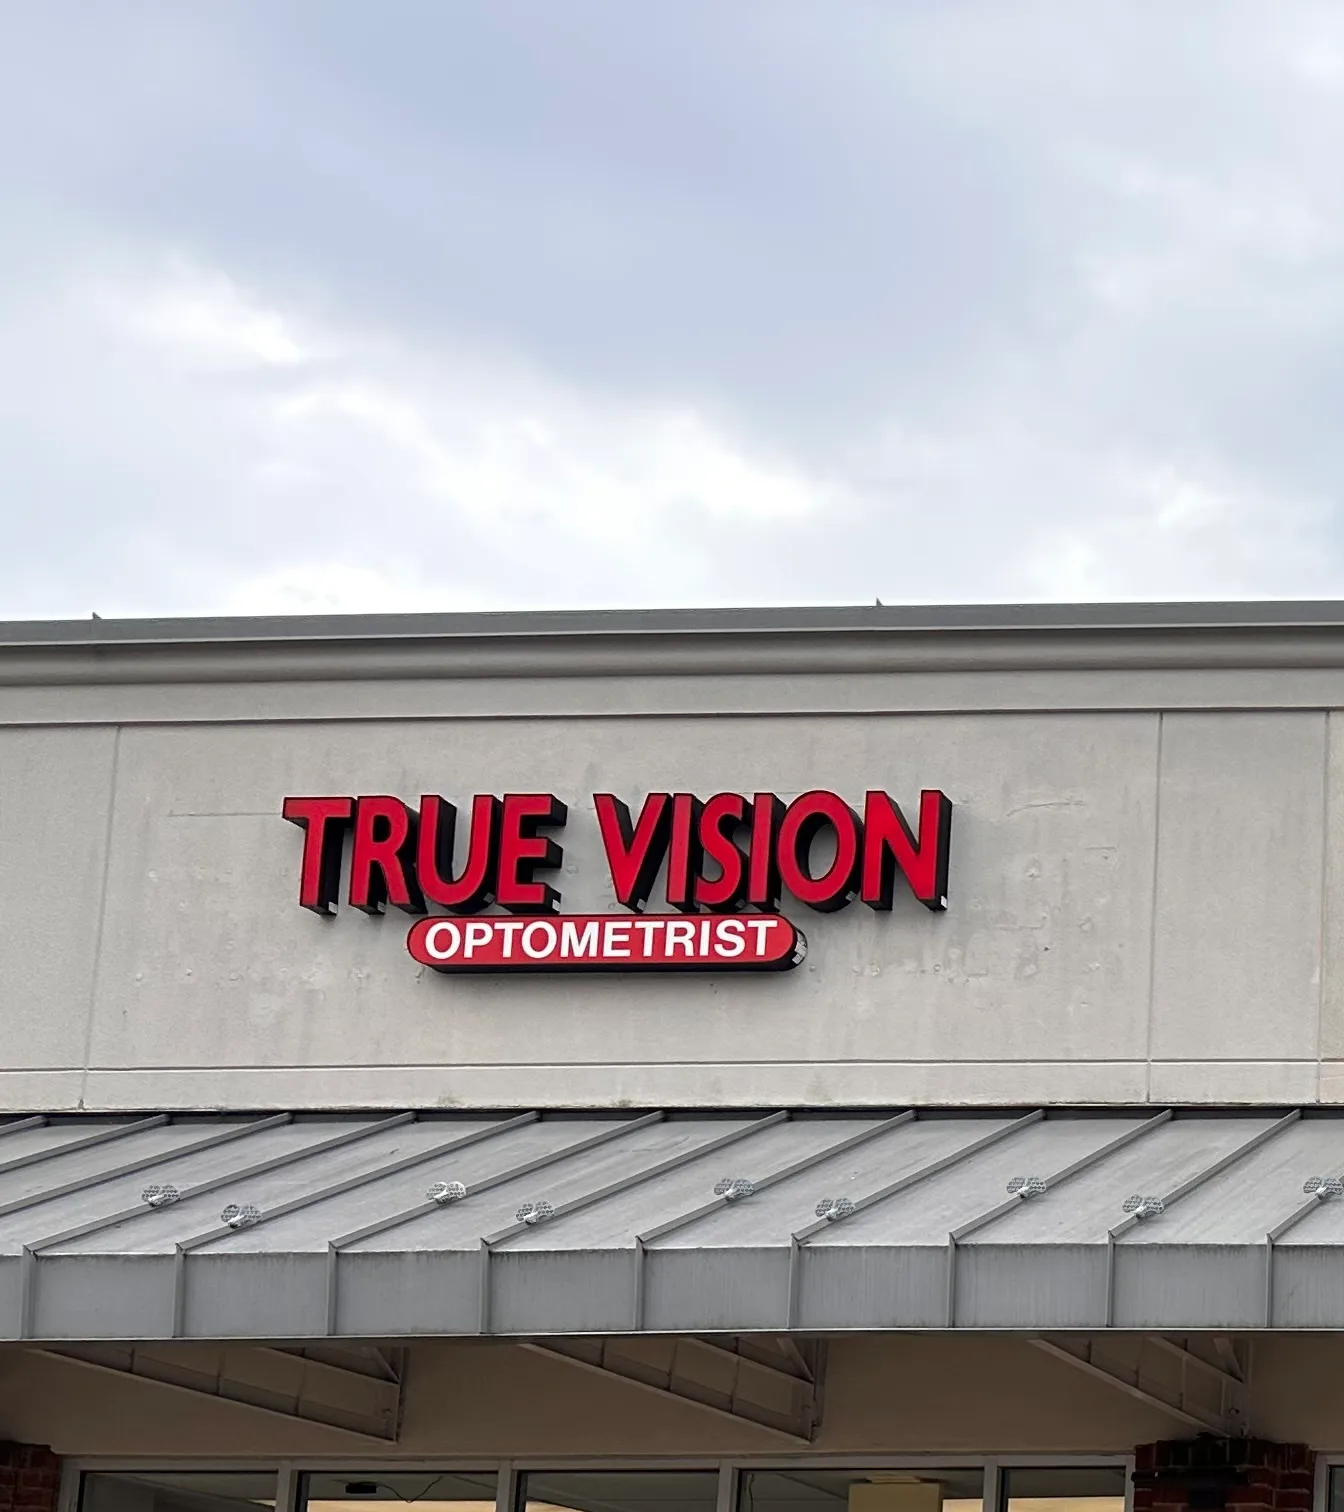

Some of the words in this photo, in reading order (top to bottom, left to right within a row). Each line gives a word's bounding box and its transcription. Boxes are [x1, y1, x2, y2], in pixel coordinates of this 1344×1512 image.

[282, 793, 567, 915] TRUE
[593, 790, 952, 912] VISION
[425, 919, 777, 959] OPTOMETRIST
